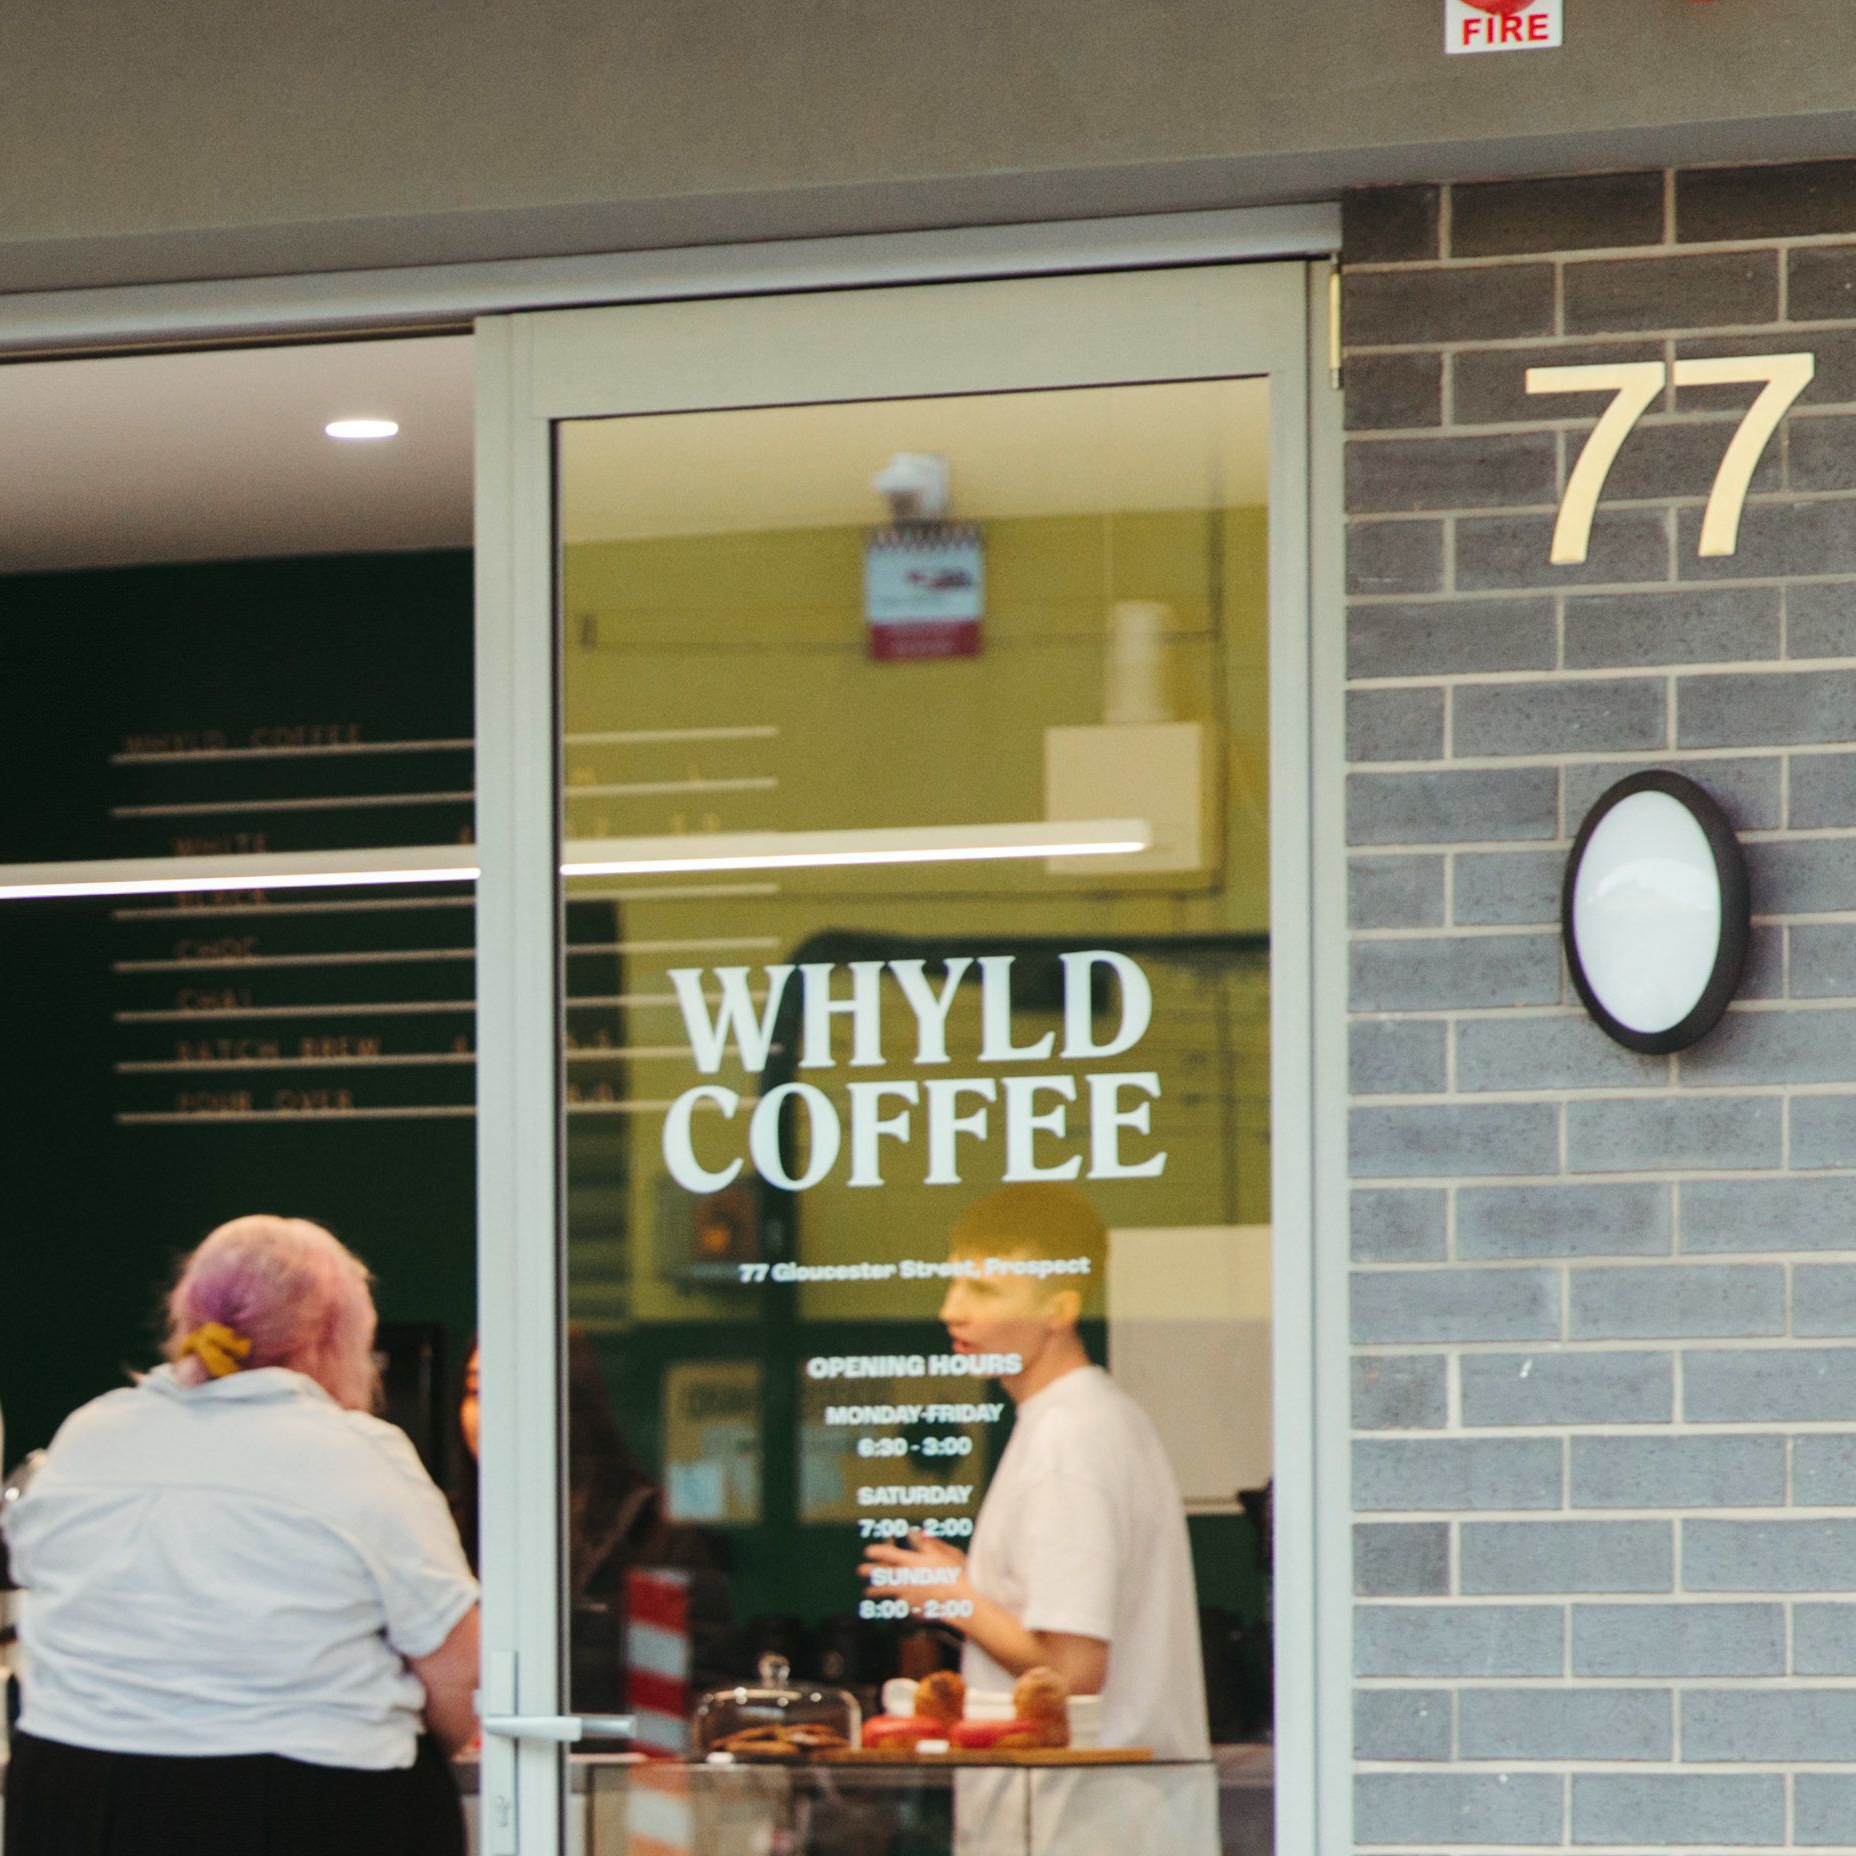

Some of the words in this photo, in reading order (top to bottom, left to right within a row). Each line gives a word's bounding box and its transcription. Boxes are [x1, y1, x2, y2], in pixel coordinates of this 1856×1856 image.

[1462, 14, 1549, 46] FIRE
[1526, 352, 1815, 564] 77
[667, 950, 1153, 1074] WHYLD
[662, 1072, 1167, 1193] COFFEE
[739, 1263, 770, 1282] 77
[771, 1262, 898, 1282] Gloucester
[899, 1258, 981, 1280] Street,
[984, 1256, 1092, 1279] Prospect
[806, 1354, 926, 1379] OPENING
[928, 1352, 1024, 1376] HOURS
[824, 1403, 1005, 1425] MONDAY-FRIDAY
[857, 1437, 909, 1457] 6:30
[922, 1436, 973, 1456] 3:00
[857, 1485, 973, 1506] SATURDAY
[858, 1518, 909, 1538] 7:00
[922, 1517, 973, 1537] 2:00
[870, 1567, 962, 1586] SUNDAY
[859, 1600, 909, 1619] 8:00
[923, 1600, 973, 1619] 2:00
